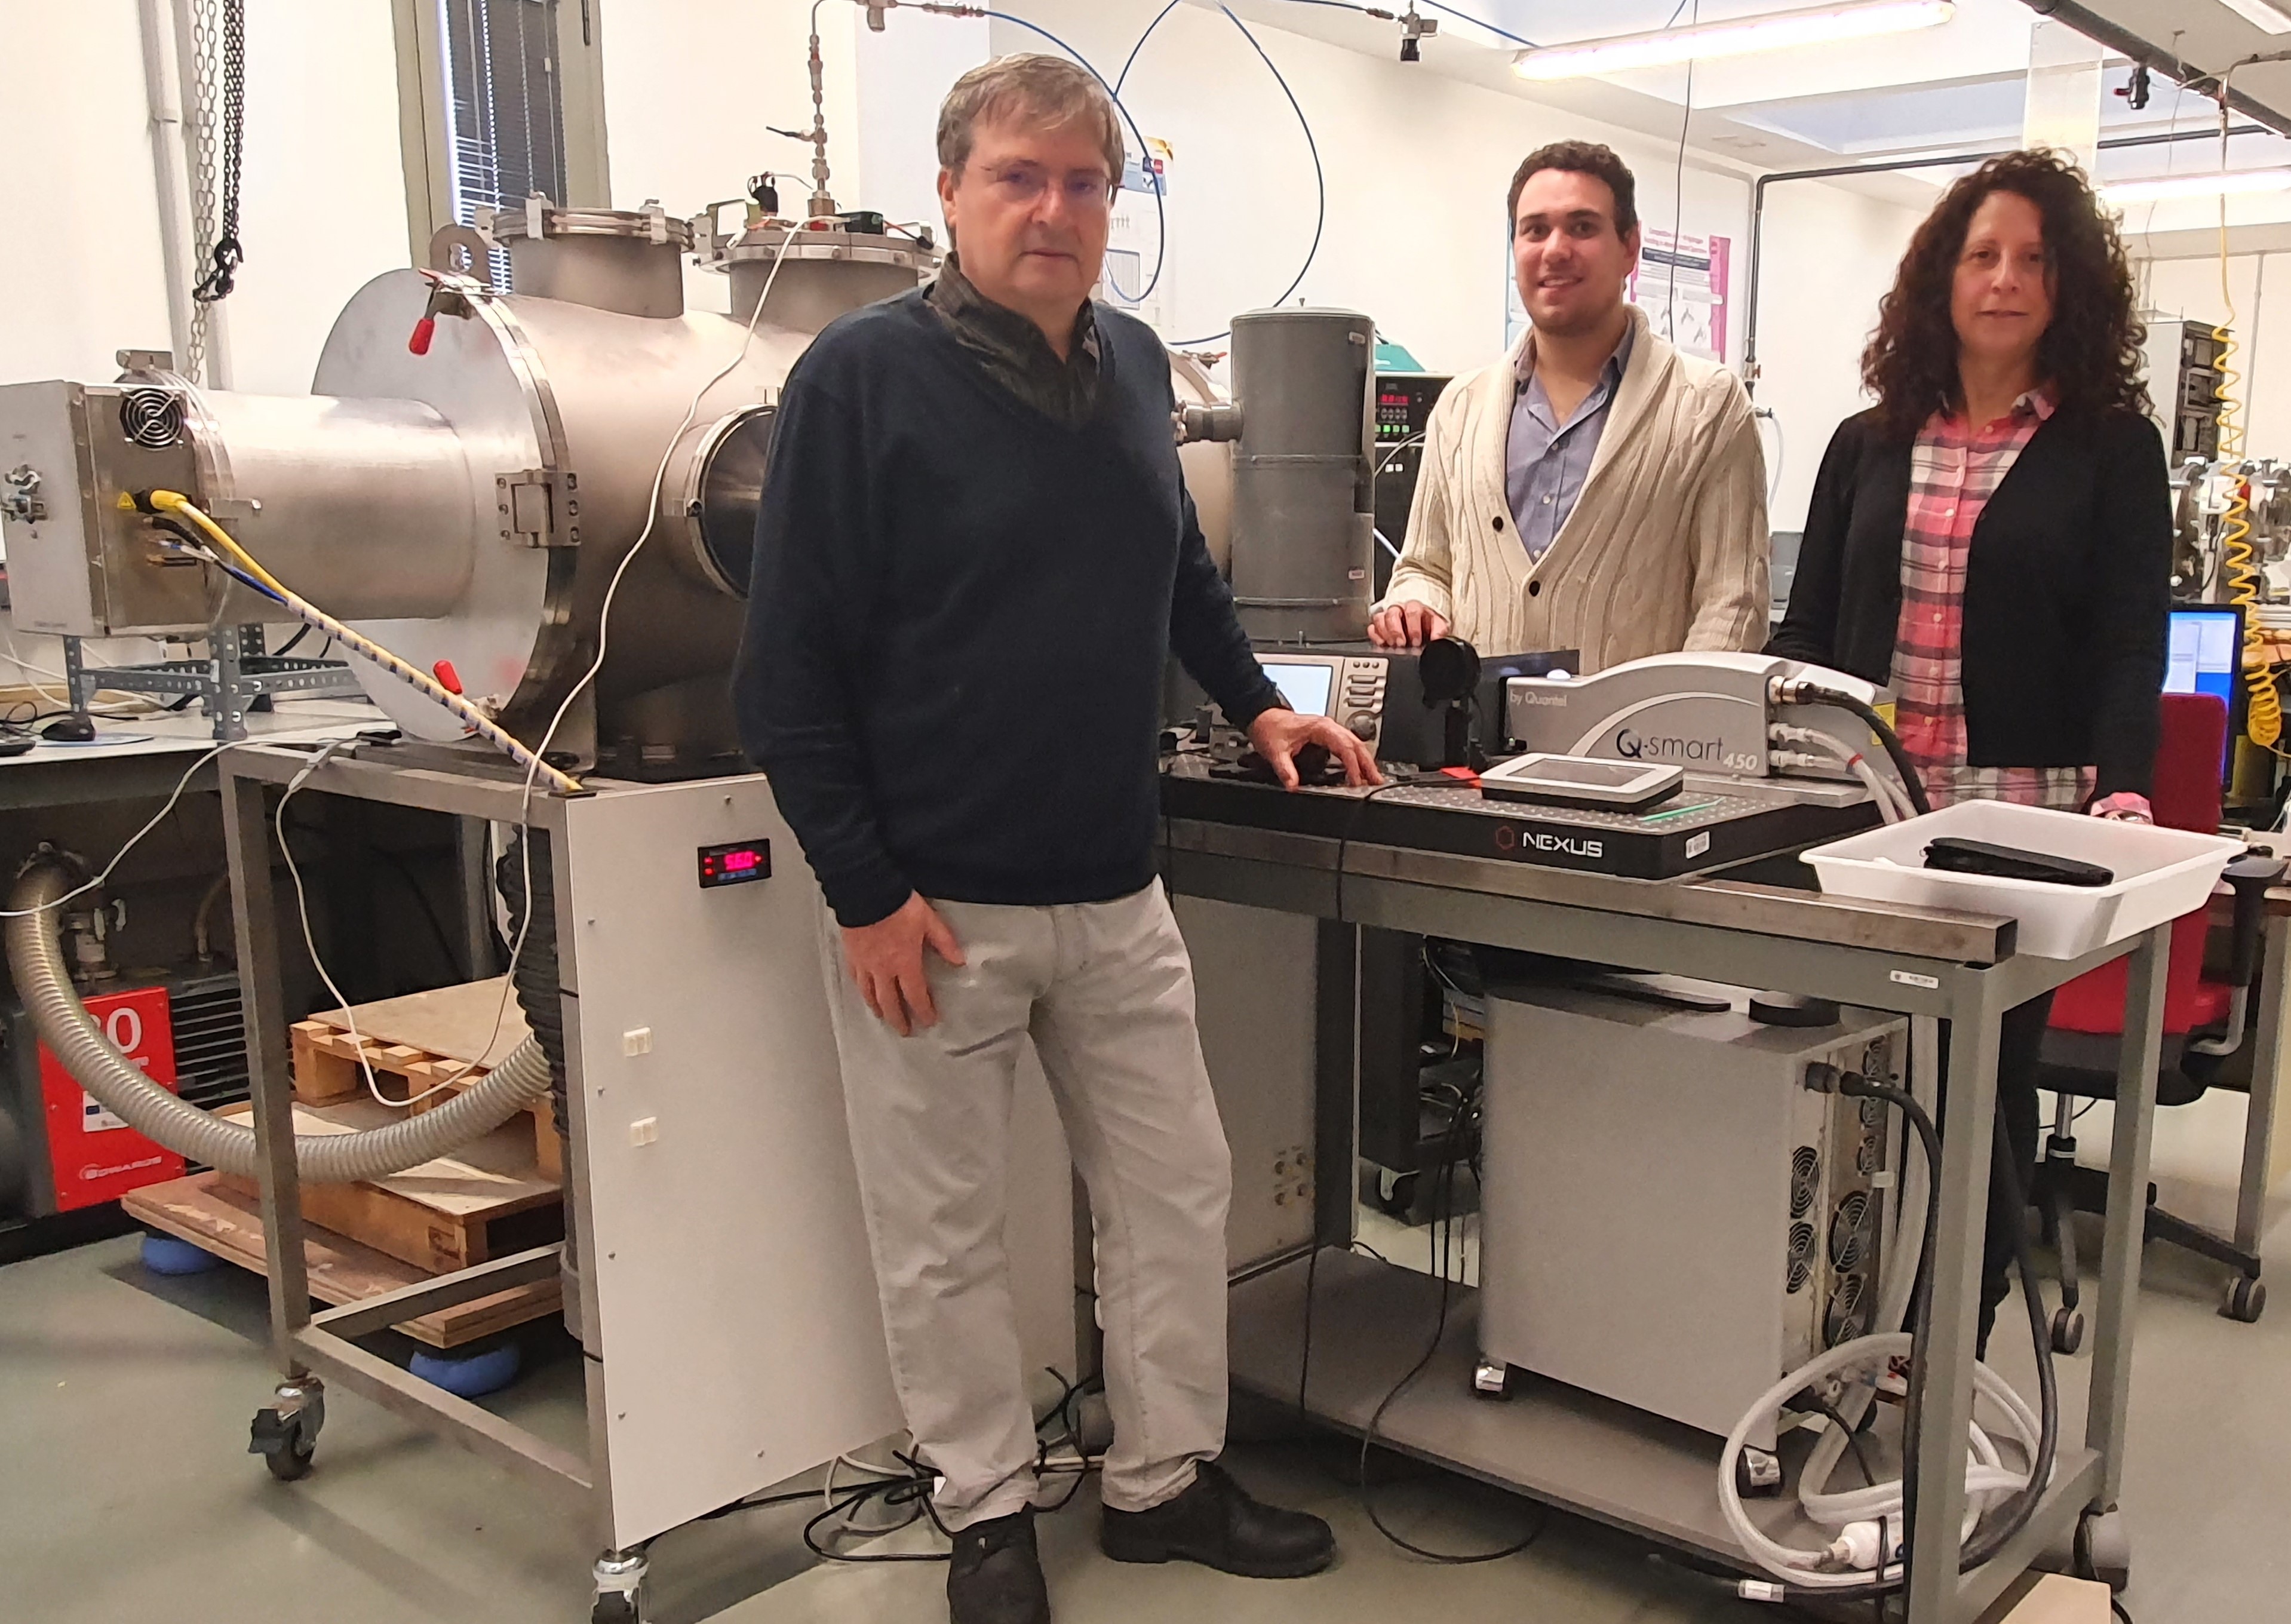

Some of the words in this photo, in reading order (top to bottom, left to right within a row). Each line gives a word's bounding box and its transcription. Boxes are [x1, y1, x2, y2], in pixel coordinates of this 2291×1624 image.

[1510, 689, 1522, 706] by
[1525, 691, 1568, 707] Quantel
[1723, 753, 1758, 770] 450
[1523, 831, 1603, 858] NEXUS
